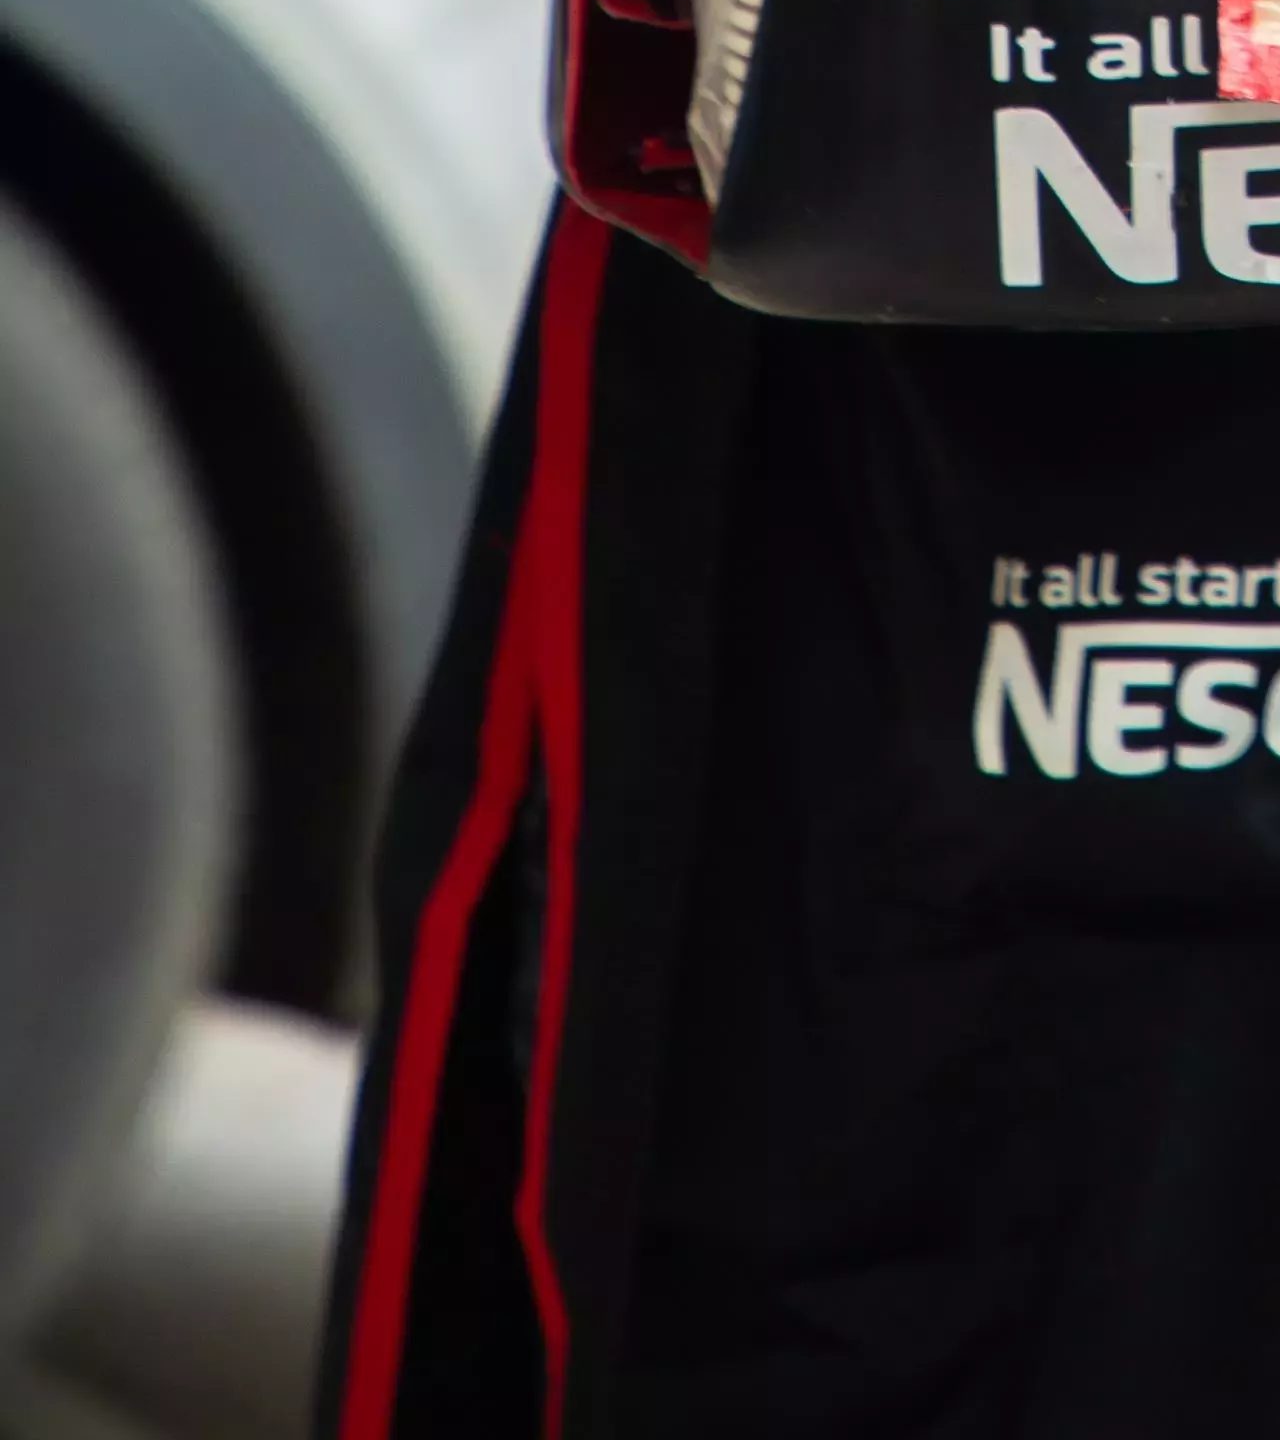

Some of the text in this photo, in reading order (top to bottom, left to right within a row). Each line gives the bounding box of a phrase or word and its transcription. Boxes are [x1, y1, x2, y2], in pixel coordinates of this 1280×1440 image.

[991, 24, 1056, 82] It
[1086, 15, 1210, 80] all
[990, 556, 1031, 608] It
[1038, 552, 1123, 609] all
